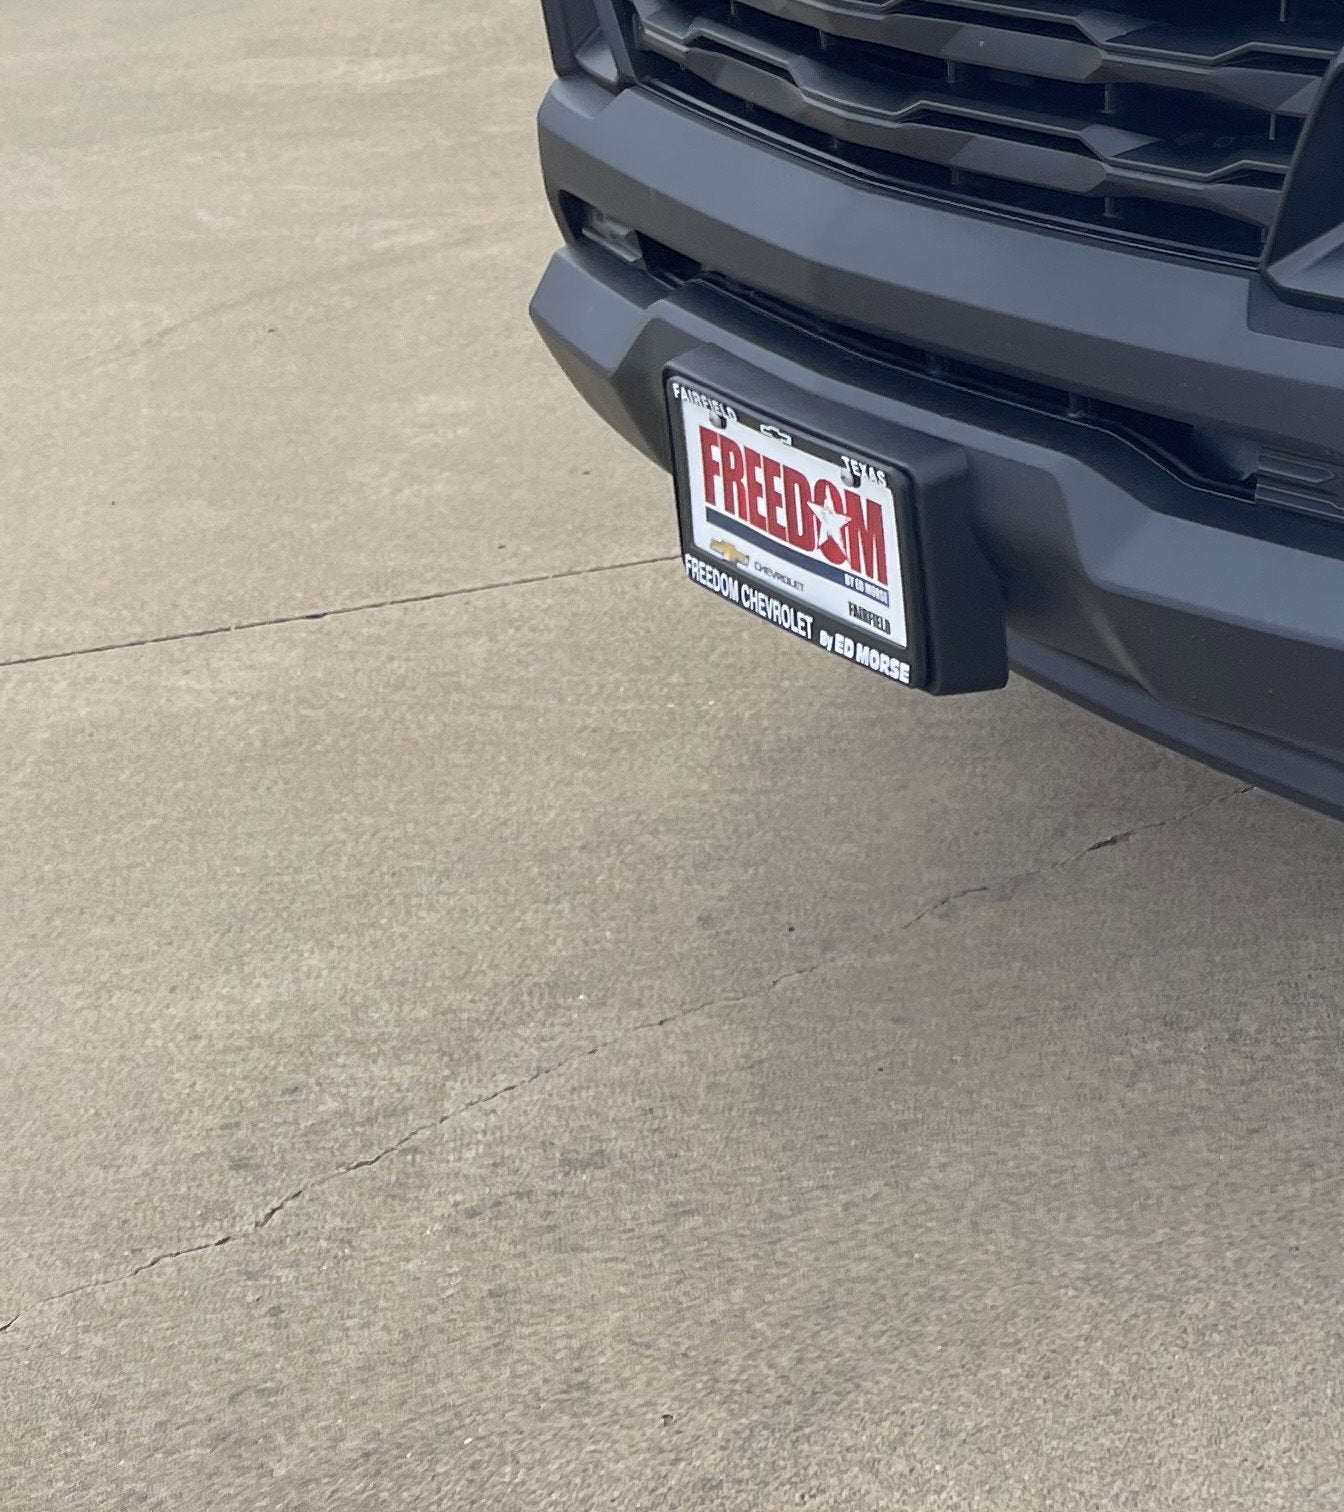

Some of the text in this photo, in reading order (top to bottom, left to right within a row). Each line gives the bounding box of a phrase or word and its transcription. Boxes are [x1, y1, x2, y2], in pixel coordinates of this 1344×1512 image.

[673, 383, 738, 422] FAIRFIELD
[699, 424, 888, 586] FREEDOM
[841, 455, 888, 488] TEXAS
[684, 553, 739, 604] FREEDOM
[741, 583, 813, 640] CHEVROLET
[834, 633, 854, 659] ED
[855, 640, 911, 685] MORSE
